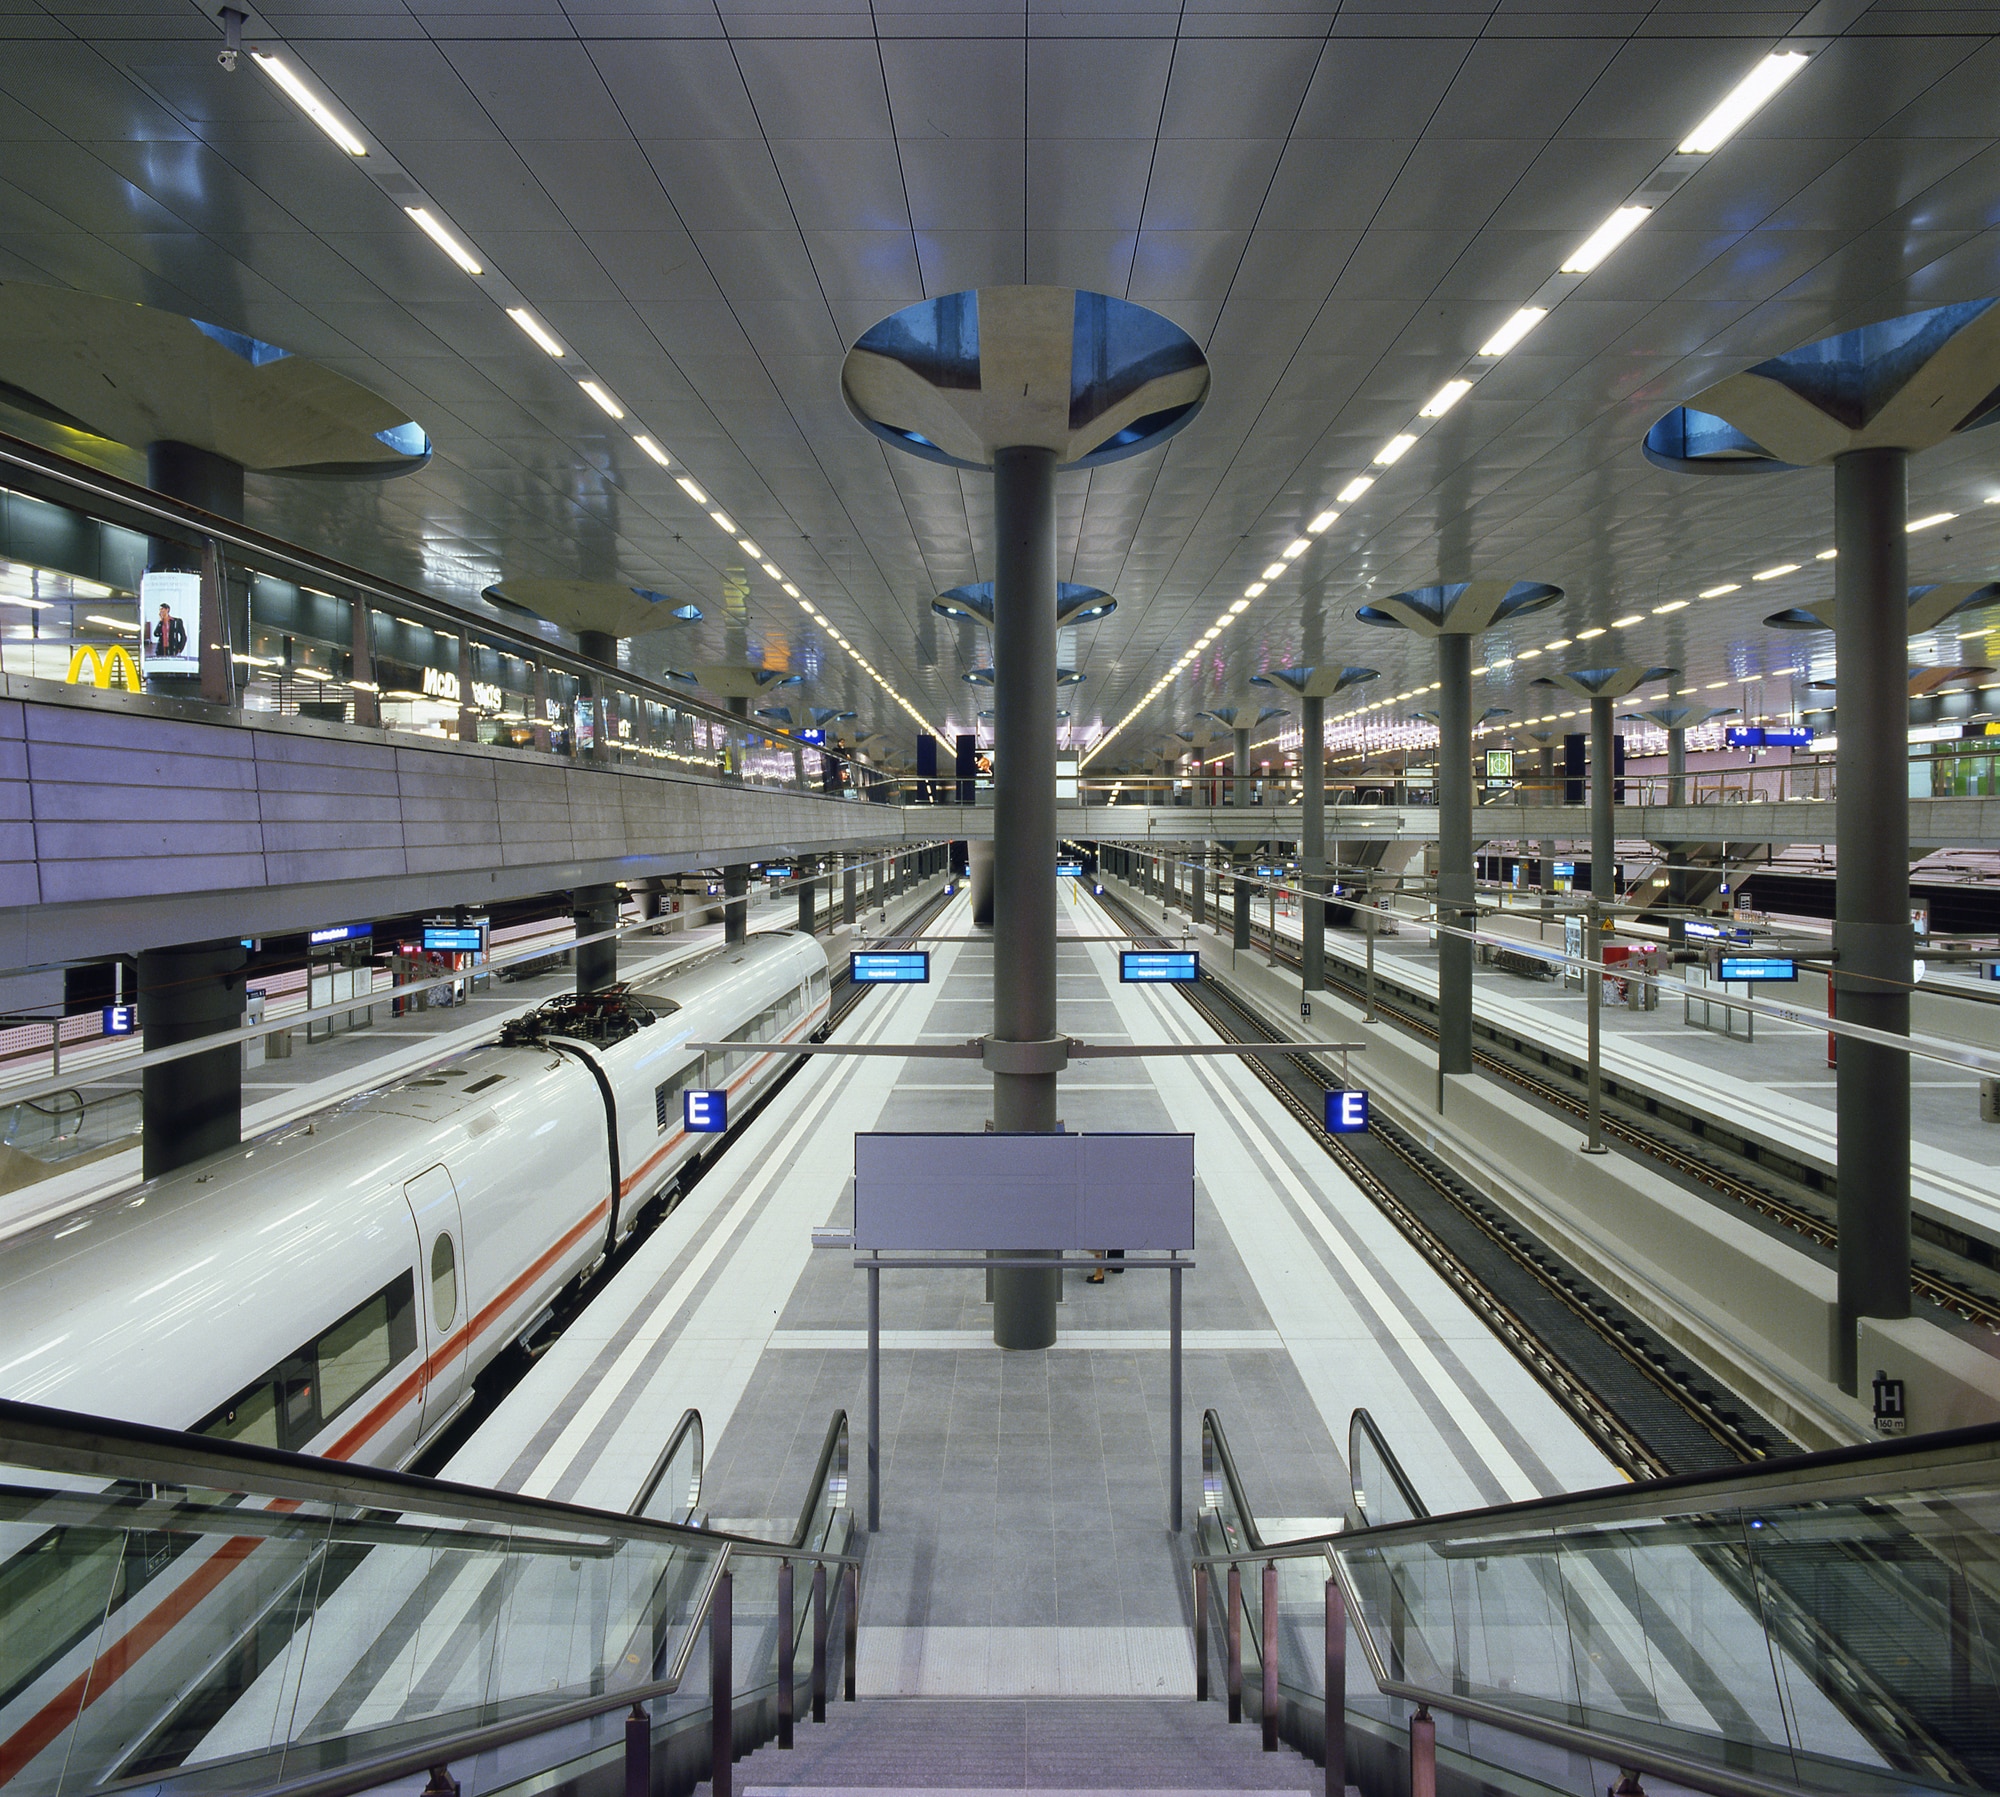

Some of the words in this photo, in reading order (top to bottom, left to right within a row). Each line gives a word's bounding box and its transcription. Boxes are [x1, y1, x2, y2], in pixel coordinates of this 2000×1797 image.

[854, 955, 861, 965] 3
[112, 1007, 128, 1030] E
[1302, 1004, 1310, 1014] H
[689, 1091, 710, 1125] E
[1342, 1092, 1364, 1125] E
[1880, 1385, 1900, 1411] H
[1879, 1419, 1893, 1428] 160
